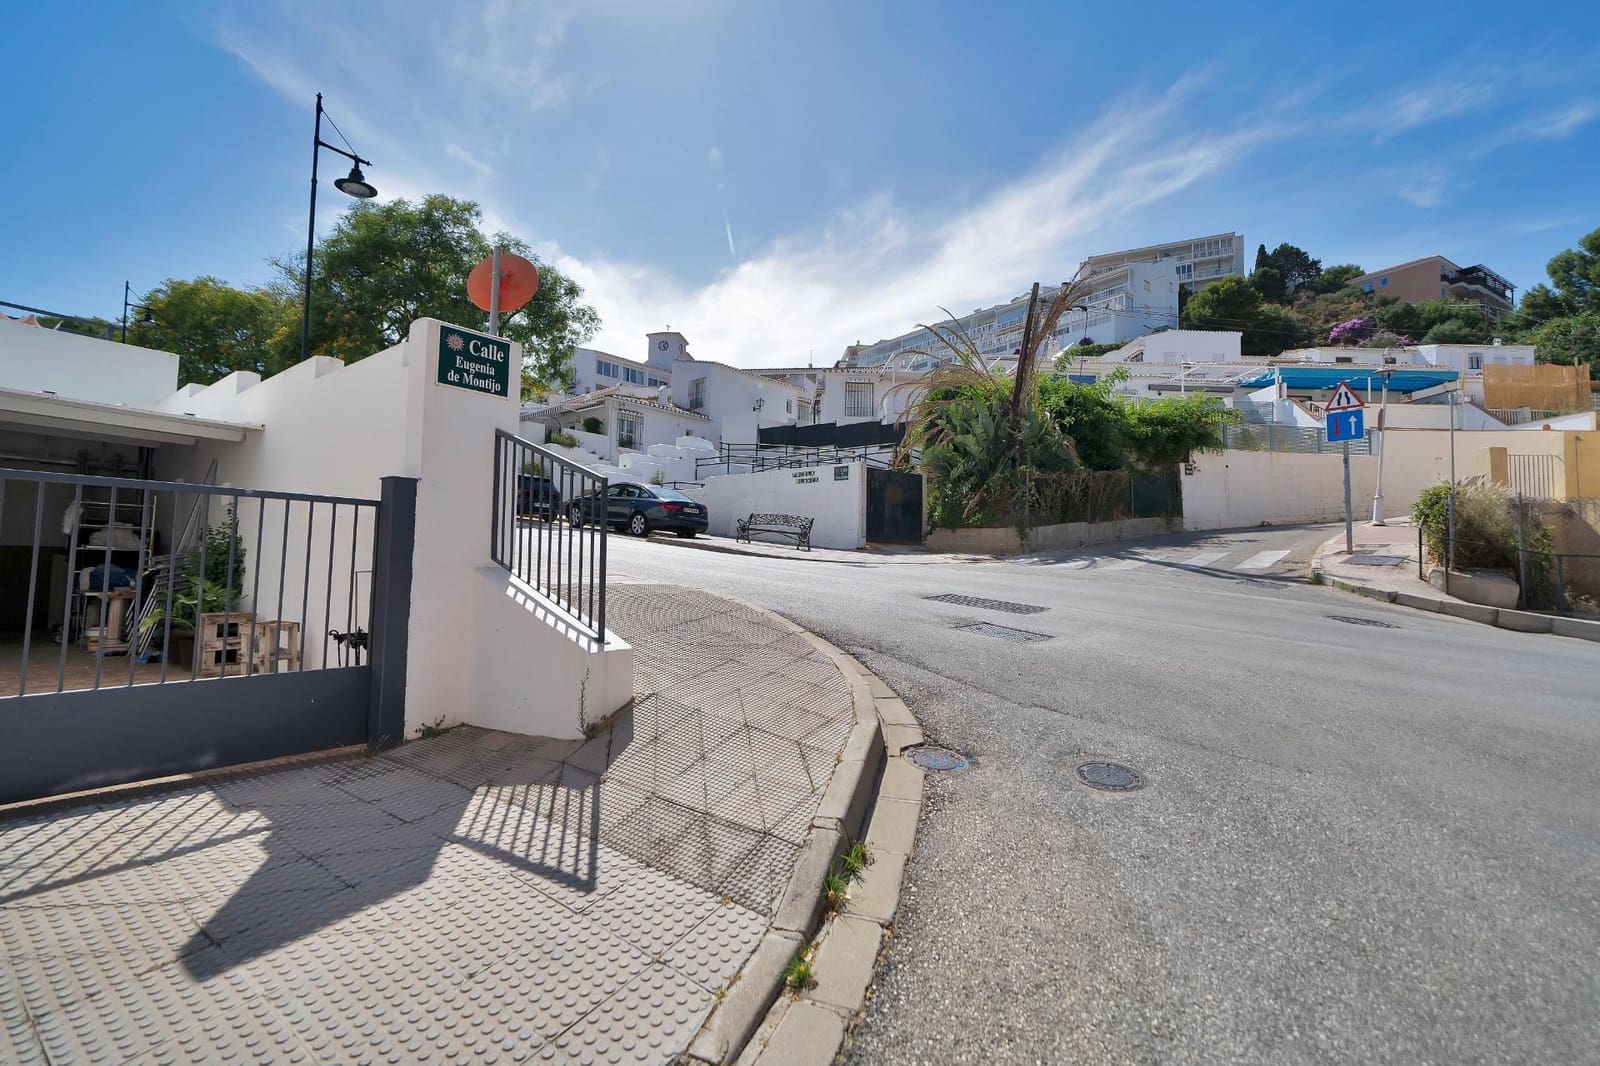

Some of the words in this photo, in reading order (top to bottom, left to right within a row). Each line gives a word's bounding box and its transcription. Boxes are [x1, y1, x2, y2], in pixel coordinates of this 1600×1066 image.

[469, 340, 504, 362] Calle
[455, 355, 495, 376] Eugenia
[447, 370, 460, 382] de
[462, 372, 501, 393] Montijo
